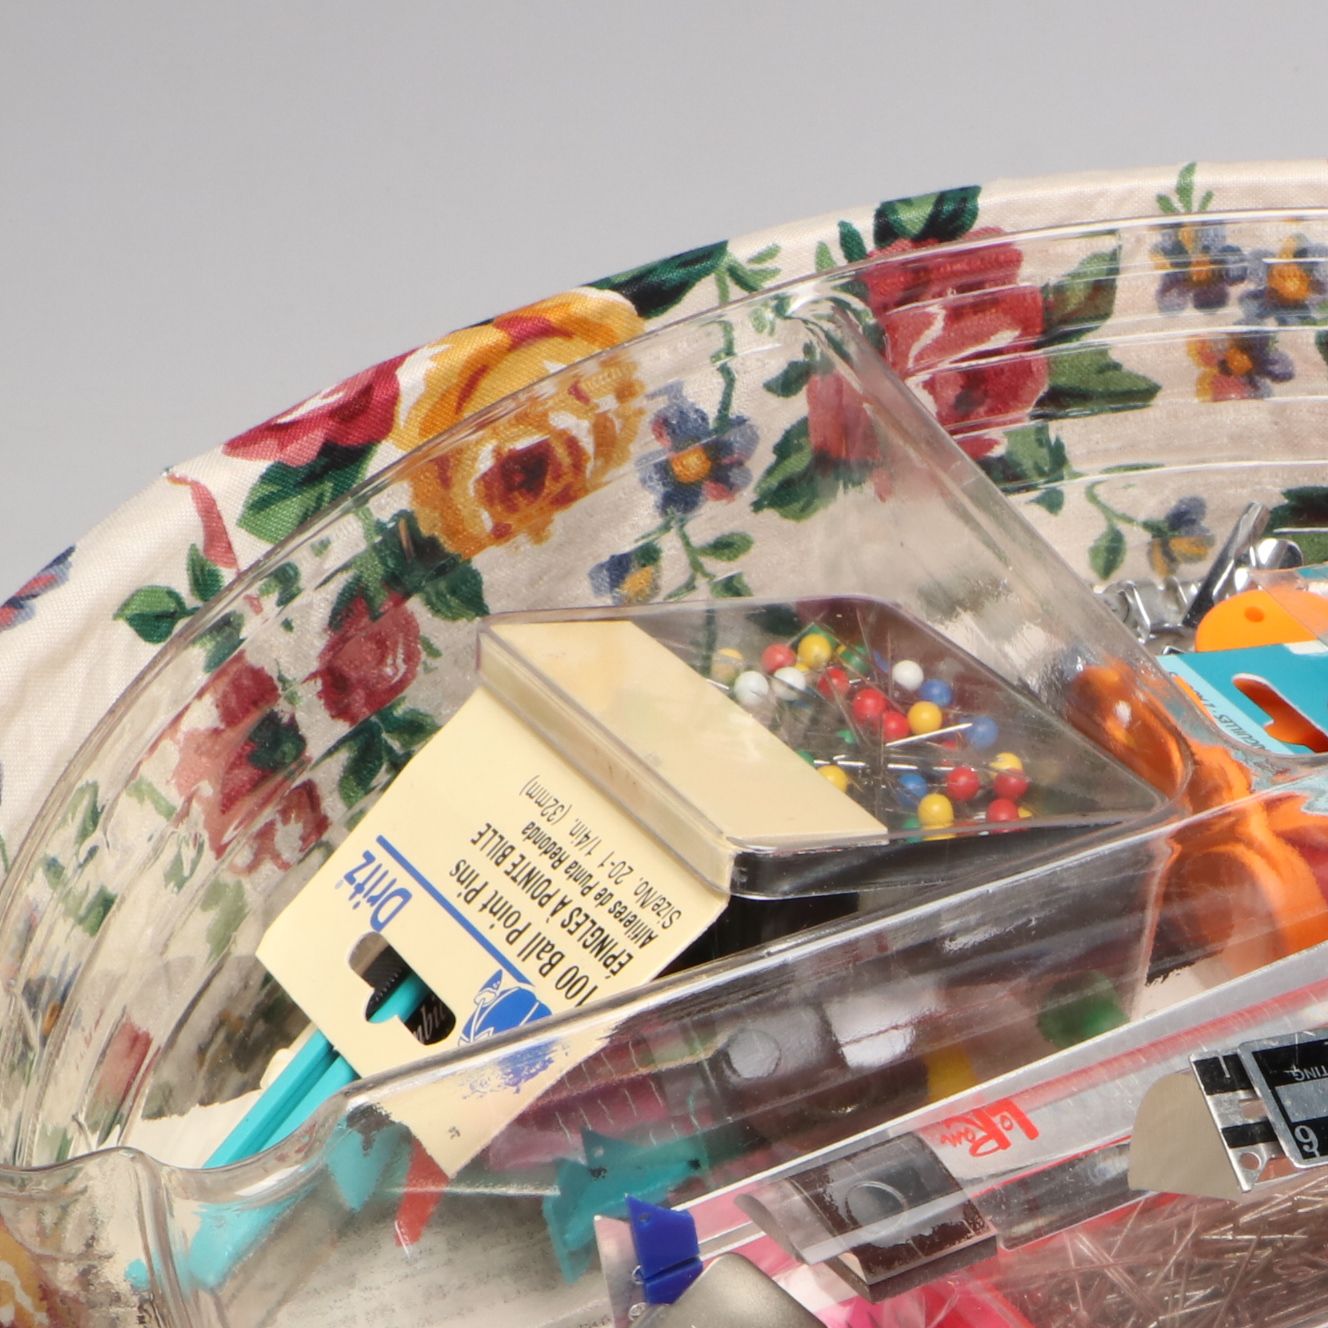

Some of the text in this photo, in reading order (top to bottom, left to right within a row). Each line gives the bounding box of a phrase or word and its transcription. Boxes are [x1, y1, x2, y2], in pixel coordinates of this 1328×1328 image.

[518, 774, 573, 826] (32mm)
[343, 850, 414, 933] Dritz
[471, 822, 634, 979] ÉPINGLES À POINTE BILLE
[521, 821, 659, 949] Alfileres de Punta Redonda
[597, 851, 635, 886] 20-1
[449, 859, 599, 1008] 100 Ball Point Pins
[633, 876, 682, 930] Size/No.
[1294, 1124, 1319, 1155] 6
